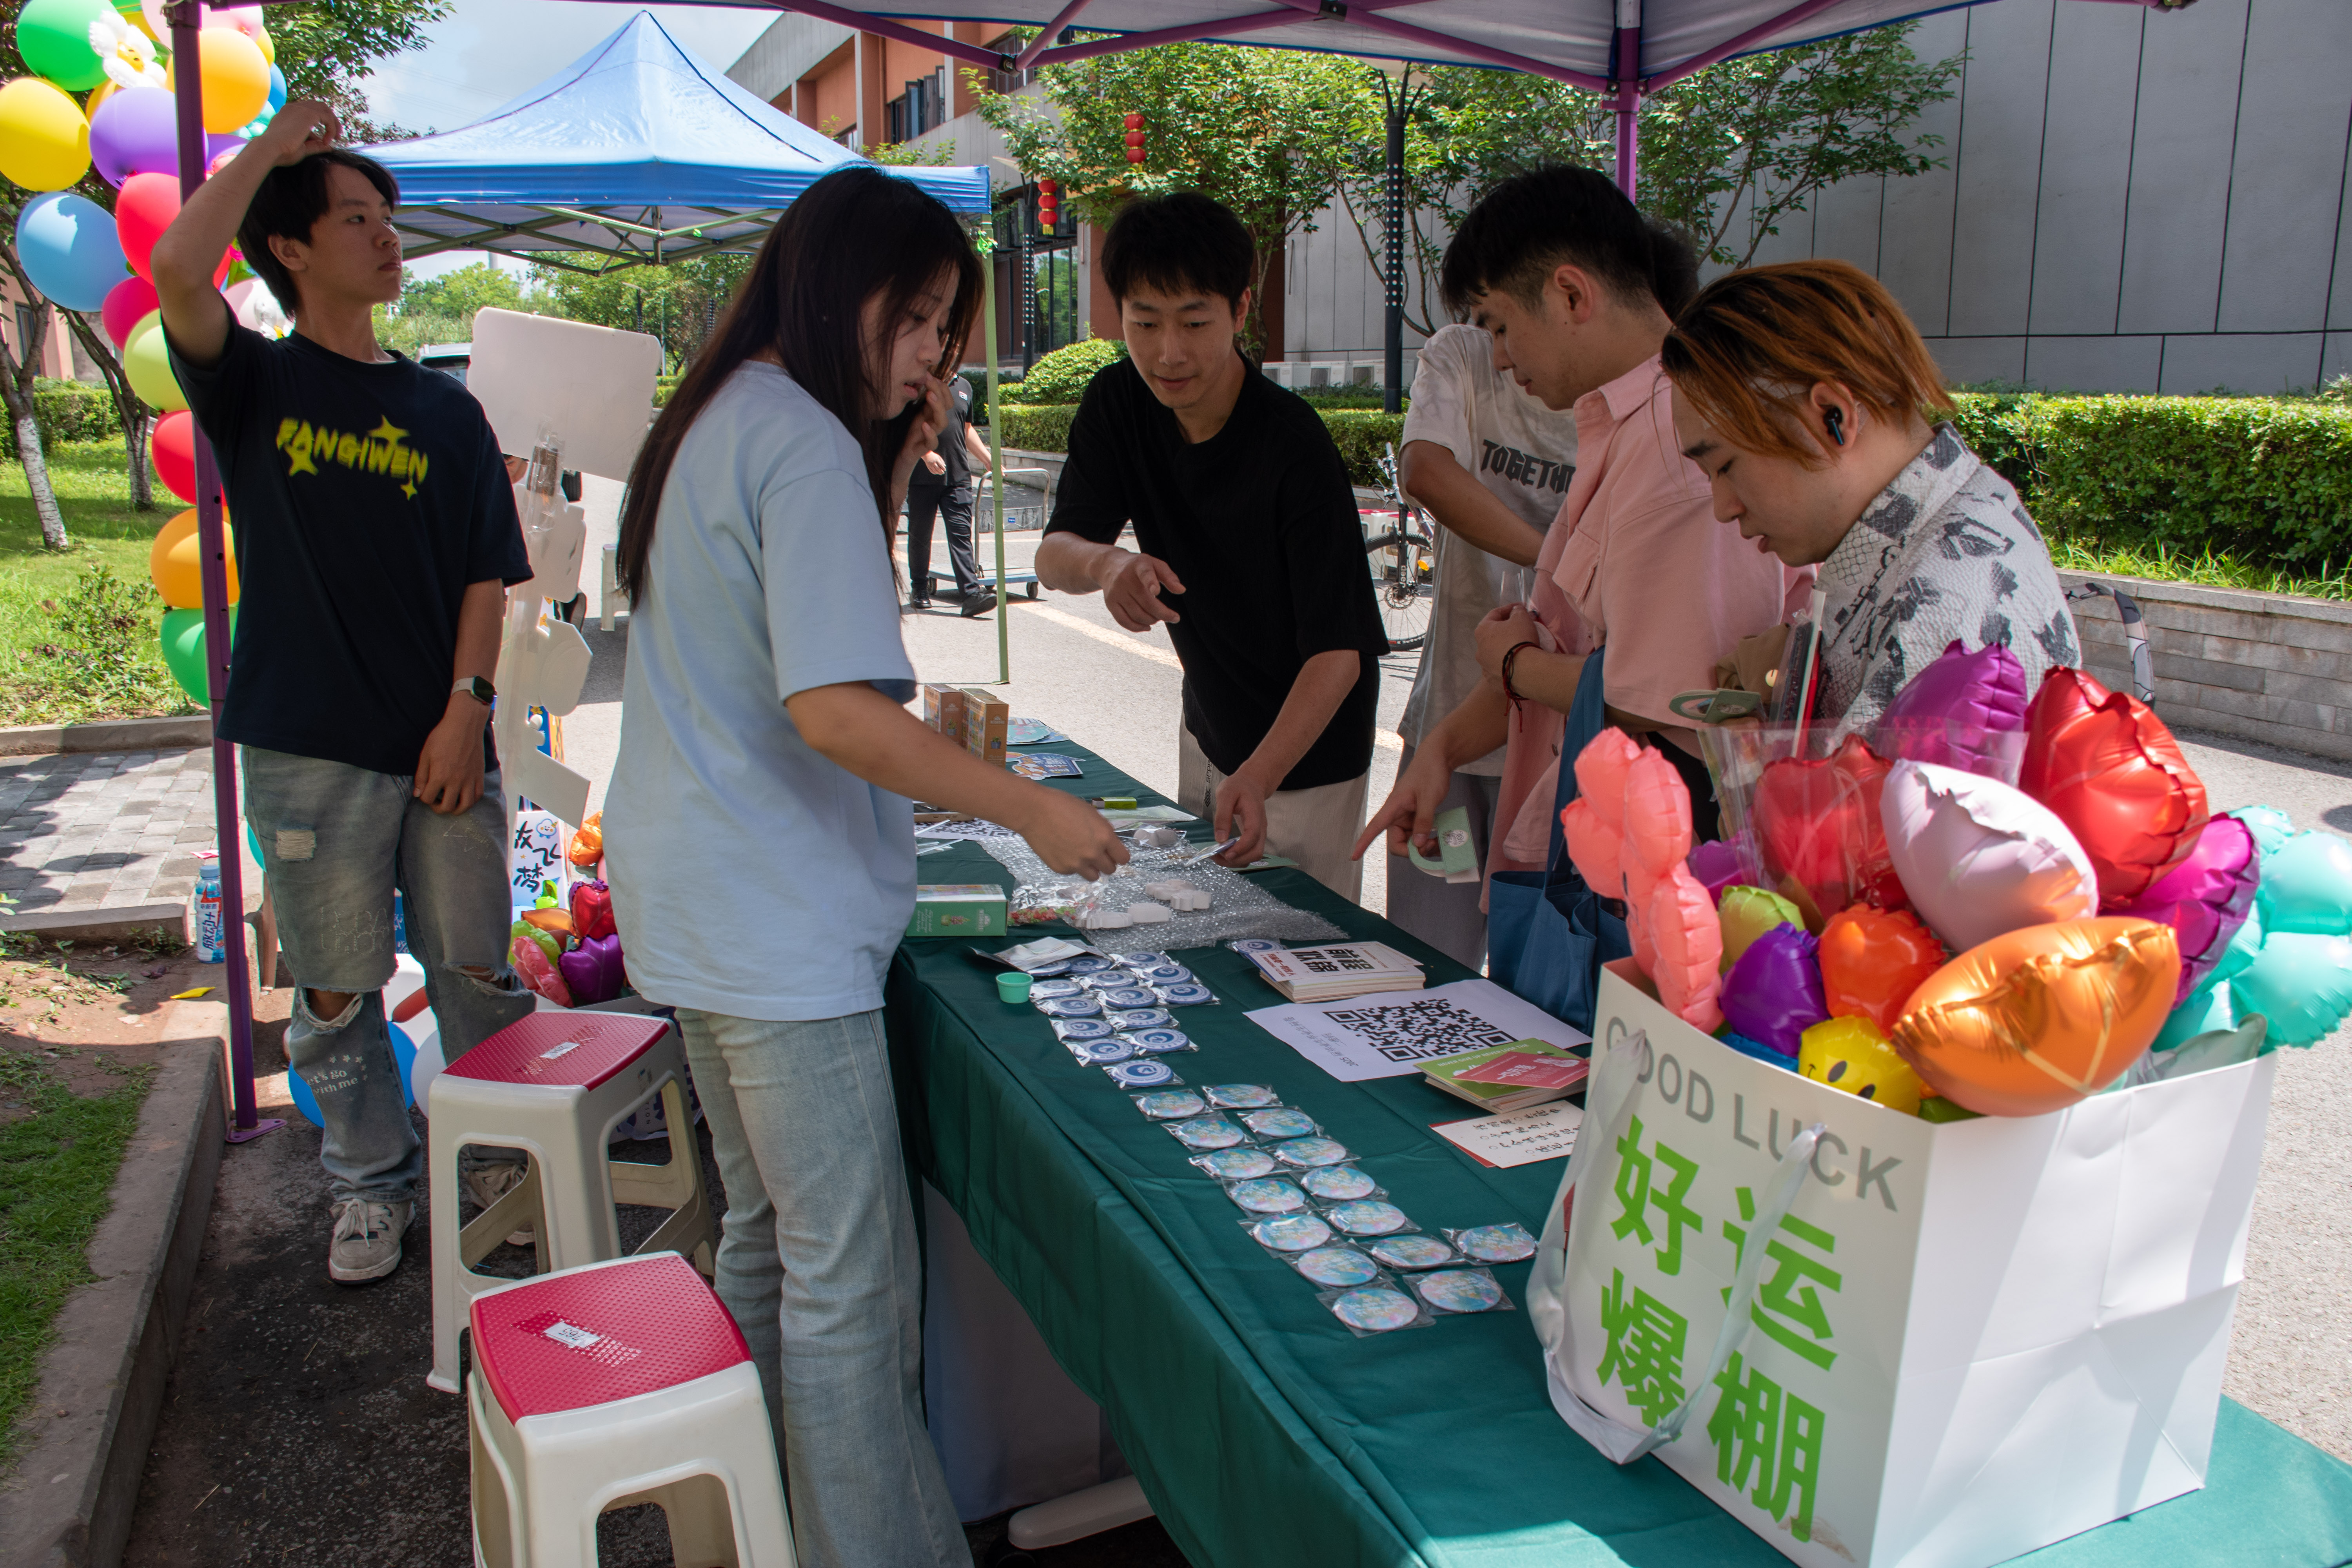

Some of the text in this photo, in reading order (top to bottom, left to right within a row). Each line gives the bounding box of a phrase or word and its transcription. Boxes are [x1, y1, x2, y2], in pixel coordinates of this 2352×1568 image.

[514, 820, 562, 906] 放飞梦
[1291, 951, 1340, 972] 似锦
[1323, 949, 1375, 969] 前程
[1321, 1033, 1347, 1046] 二维码
[1339, 1057, 1359, 1066] 2025
[1732, 1093, 1905, 1212] LUCK
[1611, 1114, 1842, 1372] 好运
[558, 1328, 585, 1341] 765
[1597, 1266, 1826, 1542] 爆棚
